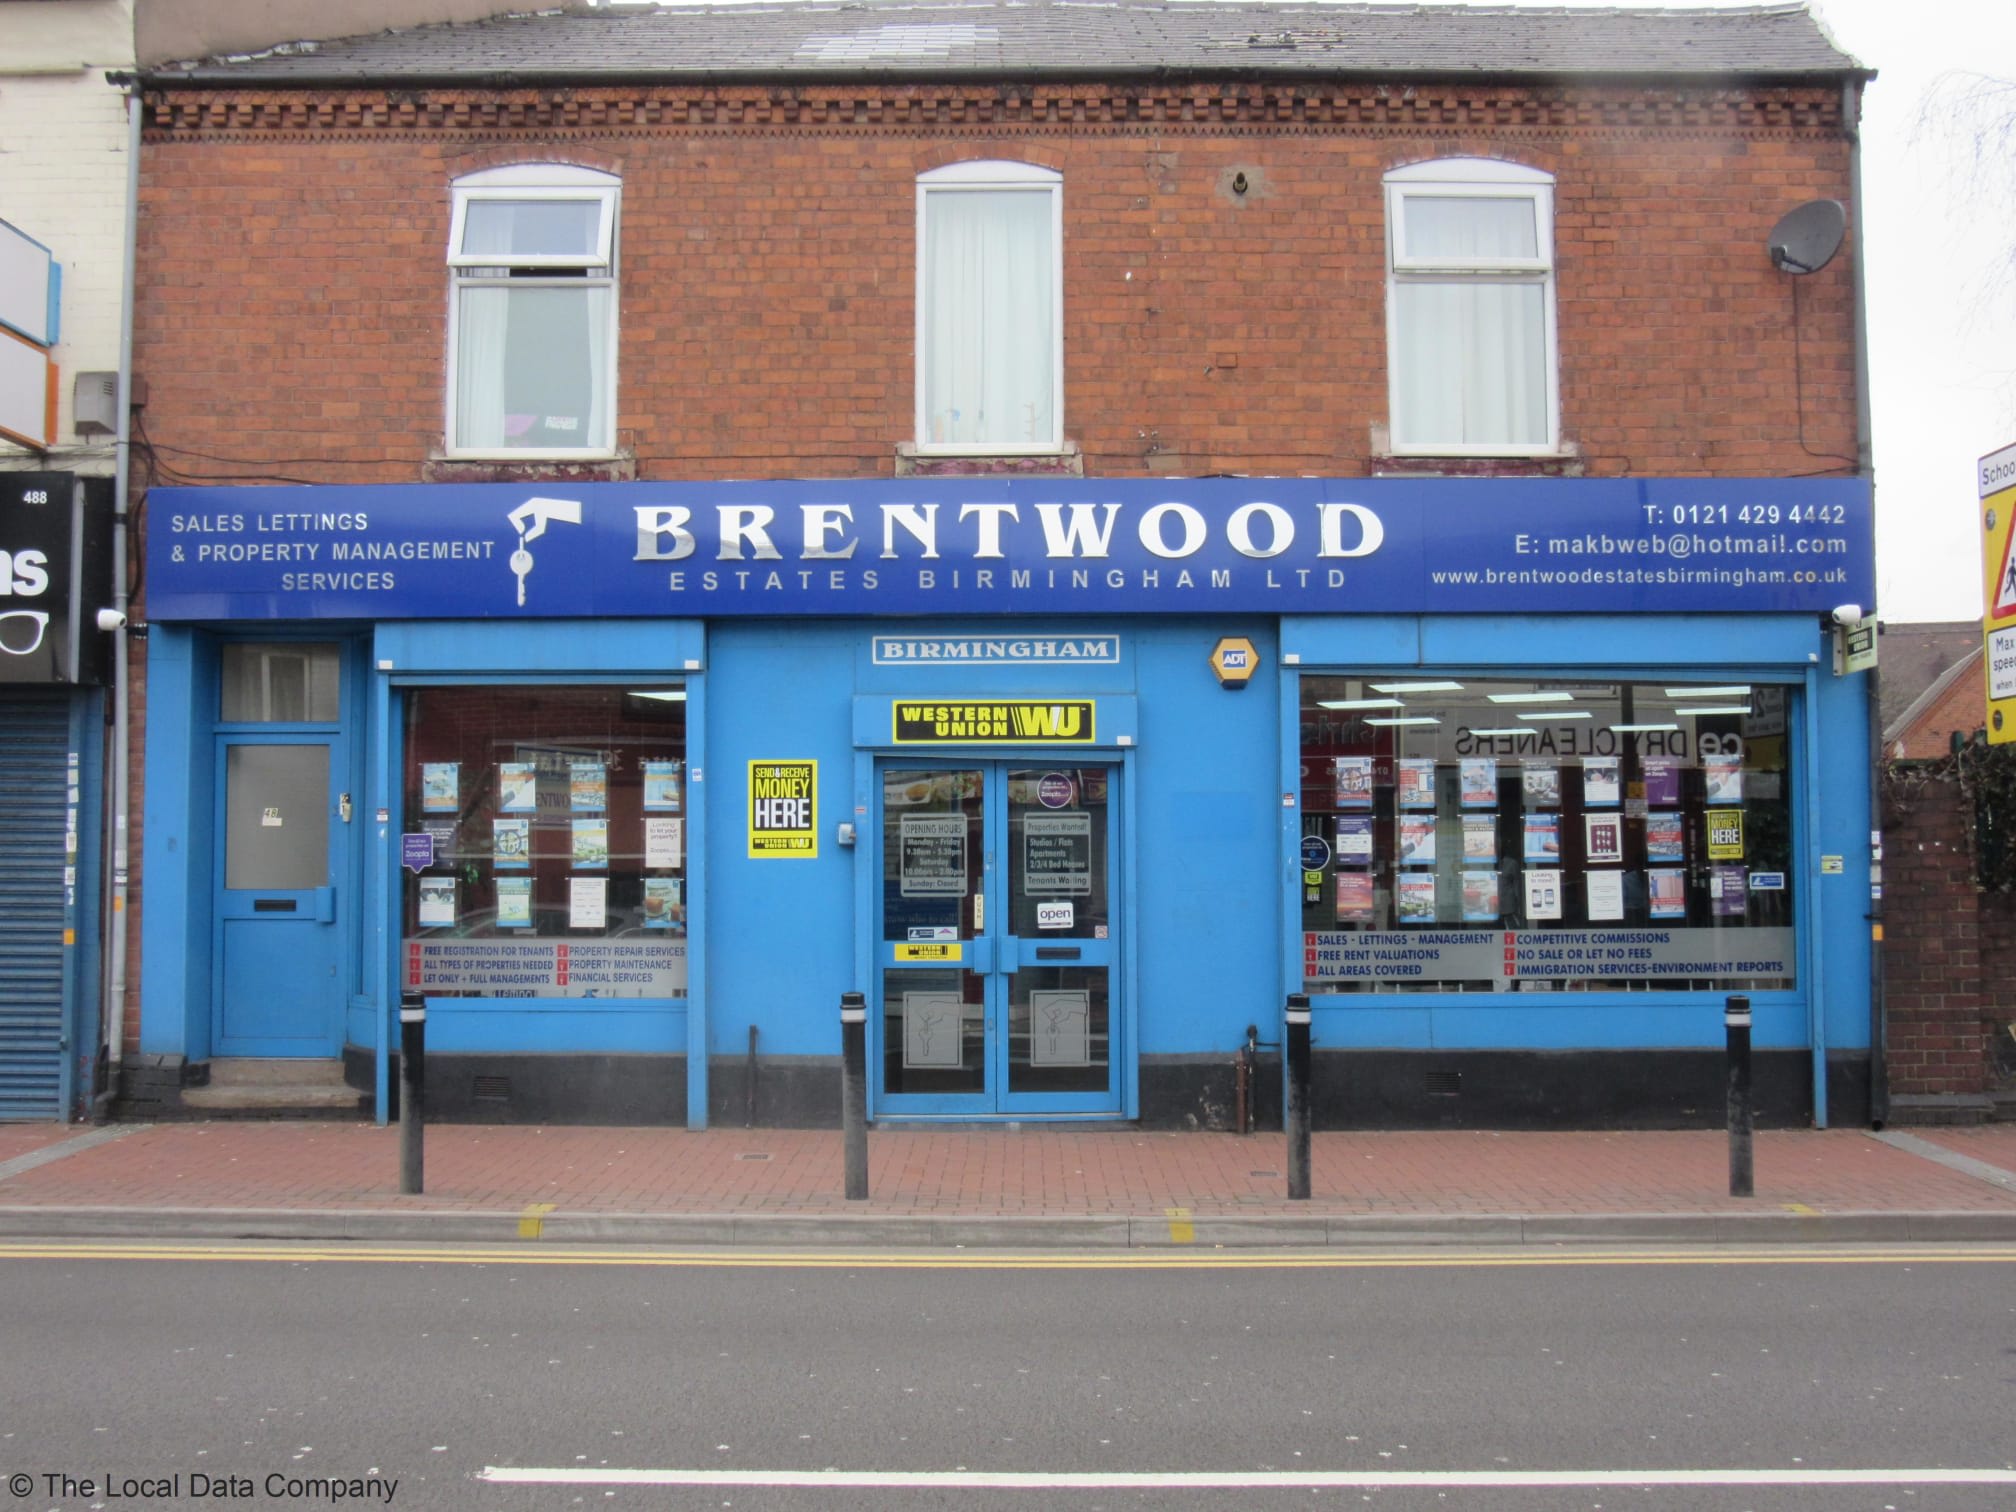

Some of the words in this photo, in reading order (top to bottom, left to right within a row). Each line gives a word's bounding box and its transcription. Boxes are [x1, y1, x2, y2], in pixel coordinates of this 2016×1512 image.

[24, 491, 47, 504] 488
[1643, 505, 1663, 524] T:
[1673, 505, 1728, 524] 0121
[1738, 505, 1780, 524] 429
[1788, 505, 1846, 524] 4442
[172, 514, 245, 533] SALES
[258, 513, 368, 531] LETTINGS
[633, 502, 1384, 561] BRENTWOOD
[171, 546, 184, 562] &
[199, 543, 319, 562] PROPERTY
[333, 541, 495, 560] MANAGEMENT
[1516, 535, 1539, 553] E:
[1550, 534, 1846, 558] makbweb@hotmail.com
[282, 572, 395, 590] SERVICES
[670, 570, 878, 591] ESTATES
[920, 568, 1231, 590] BIRMINGHAM
[1267, 568, 1345, 589] LTD
[1432, 568, 1846, 587] www.brentwoodestatesbirmingham.co.uk
[883, 641, 1108, 658] BIRMINGHAM
[1996, 637, 2015, 652] Max
[1223, 653, 1246, 664] ADT
[902, 707, 1008, 722] WESTERN
[1019, 706, 1080, 736] WU
[936, 722, 1008, 736] UNION
[755, 779, 809, 798] MONEY
[755, 799, 809, 828] HERE
[905, 824, 936, 834] OPENING
[938, 824, 962, 834] HOURS
[1711, 829, 1739, 844] HERE
[1030, 849, 1066, 858] Apartments
[1028, 876, 1056, 885] Tenants
[1040, 909, 1071, 921] open
[1317, 935, 1347, 945] SALES
[1359, 934, 1408, 945] LETTINGS
[1418, 933, 1494, 944] MANAGEMENT
[1517, 934, 1587, 945] COMPETITIVE
[1591, 933, 1670, 944] COMMISSIONS
[424, 946, 442, 955] FREE
[444, 946, 499, 955] REGISTRATION
[501, 946, 517, 955] FOR
[518, 946, 553, 955] TENANTS
[569, 947, 612, 956] PROPERTY
[614, 947, 643, 956] REPAIR
[645, 947, 685, 956] SERVICES
[1318, 950, 1341, 961] FREE
[1344, 950, 1370, 960] RENT
[1373, 949, 1440, 960] VALUATIONS
[1517, 949, 1534, 960] NO
[1538, 949, 1563, 960] SALE
[1567, 949, 1583, 960] OR
[1586, 949, 1602, 959] LET
[1607, 949, 1624, 959] NO
[1628, 948, 1652, 959] FEES
[424, 960, 437, 969] ALL
[439, 960, 462, 969] TYPES
[463, 960, 474, 969] OF
[476, 960, 521, 969] PROPERTIES
[522, 960, 553, 970] NEEDED
[569, 960, 612, 969] PROPERTY
[614, 960, 672, 969] MAINTENANCE
[1317, 965, 1336, 976] ALL
[1339, 965, 1371, 976] AREAS
[1375, 964, 1422, 975] COVERED
[1517, 964, 1594, 976] IMMIGRATION
[1737, 961, 1783, 972] REPORTS
[424, 974, 436, 983] LET
[438, 974, 459, 984] ONLY
[469, 974, 488, 983] FULL
[489, 974, 550, 984] MANAGEMENTS
[569, 973, 611, 982] FINANCIAL
[613, 972, 653, 982] SERVICES
